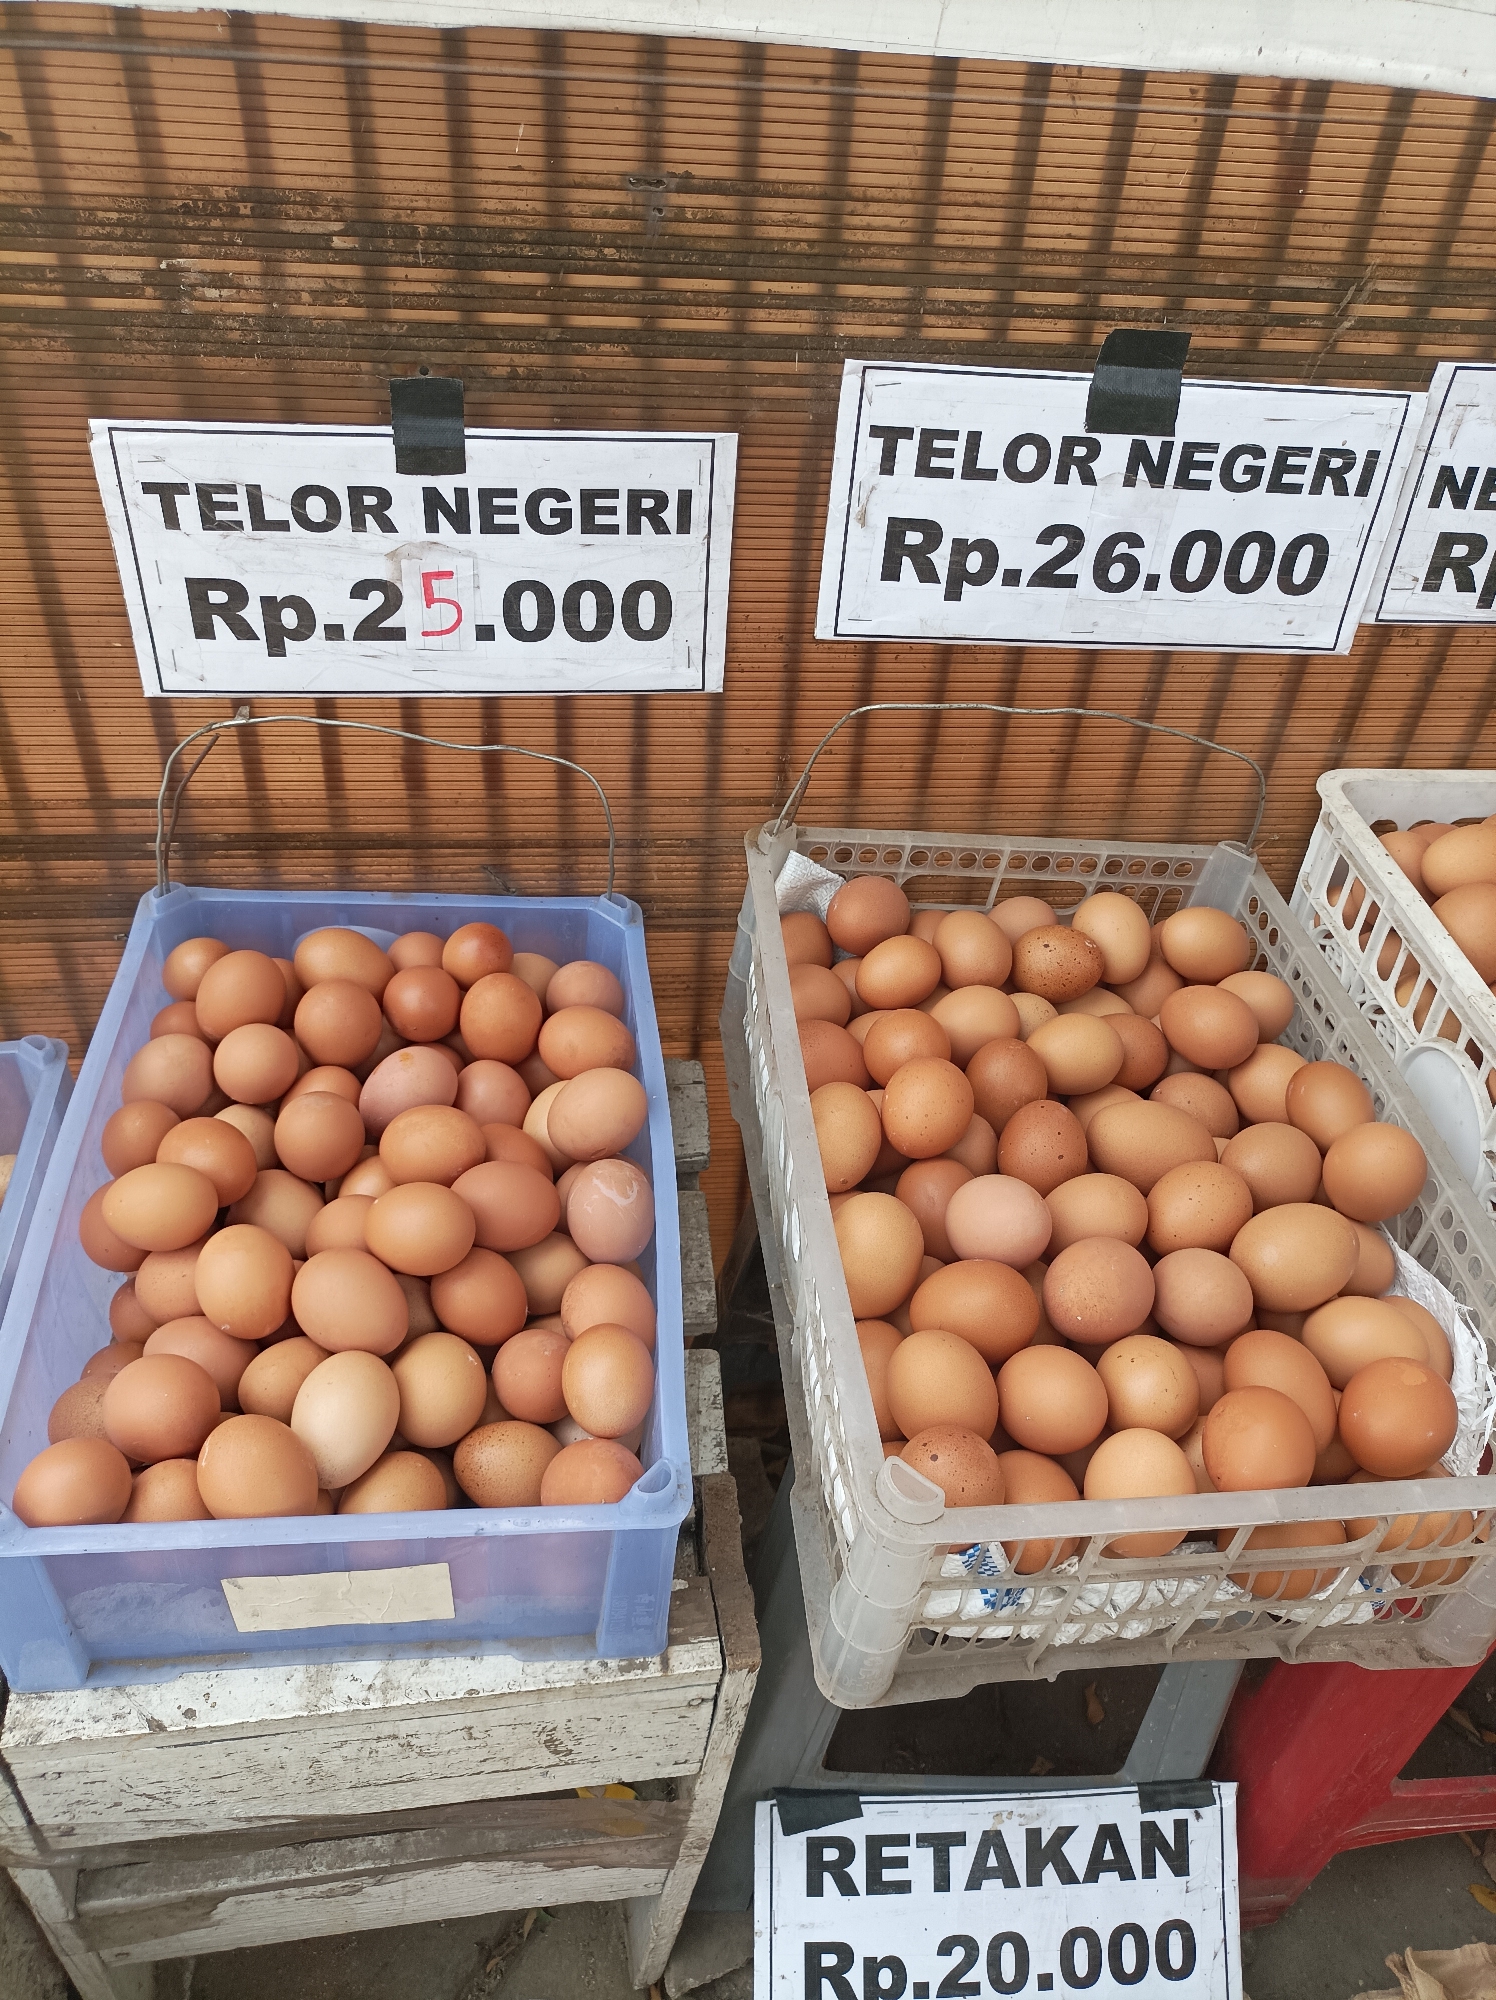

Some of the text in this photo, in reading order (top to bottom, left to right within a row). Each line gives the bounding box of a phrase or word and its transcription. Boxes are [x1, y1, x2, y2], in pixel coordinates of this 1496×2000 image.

[869, 425, 1381, 498] TELOR NEGERI
[141, 482, 692, 536] TELOR NEGERI
[881, 516, 1329, 602] Rp.26.000
[185, 577, 672, 658] Rp.25.000
[806, 1818, 1190, 1898] RETAKAN
[804, 1918, 1196, 2000] Rp.20.000
